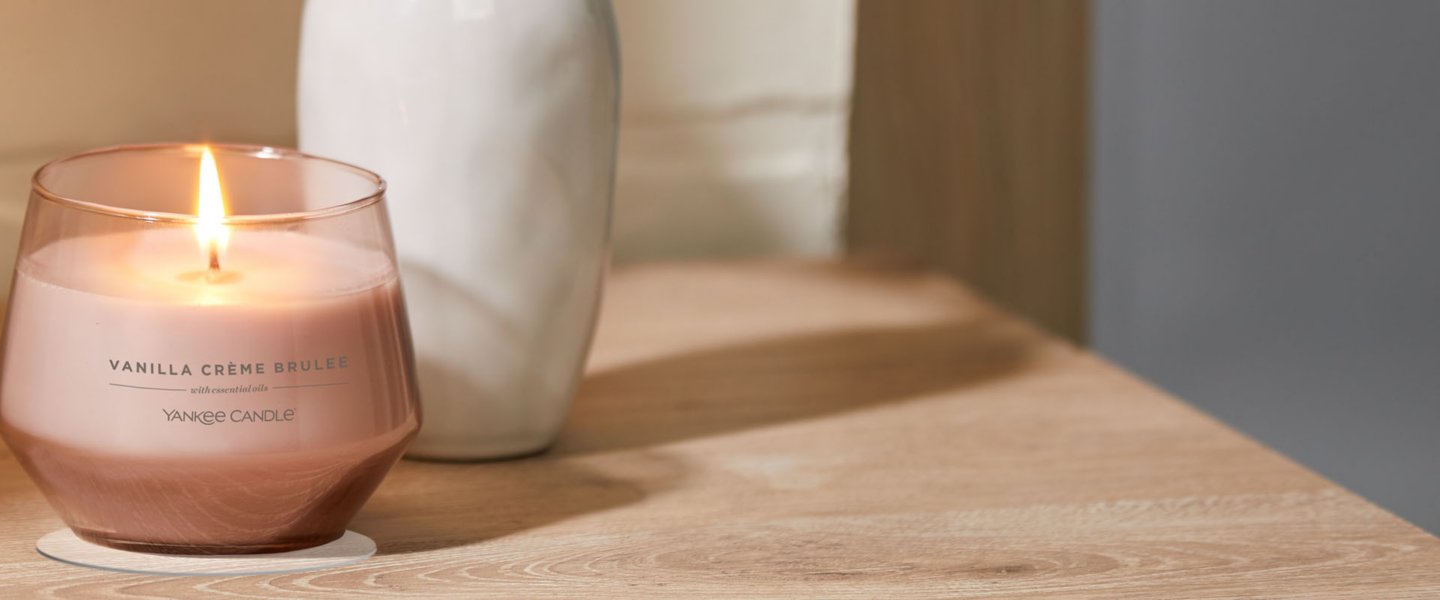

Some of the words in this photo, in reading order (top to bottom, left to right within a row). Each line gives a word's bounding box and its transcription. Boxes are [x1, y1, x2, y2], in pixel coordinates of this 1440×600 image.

[109, 359, 192, 376] VANILLA
[201, 361, 265, 376] CRÈME
[190, 386, 210, 394] with
[211, 385, 251, 394] essential
[251, 384, 268, 393] oils
